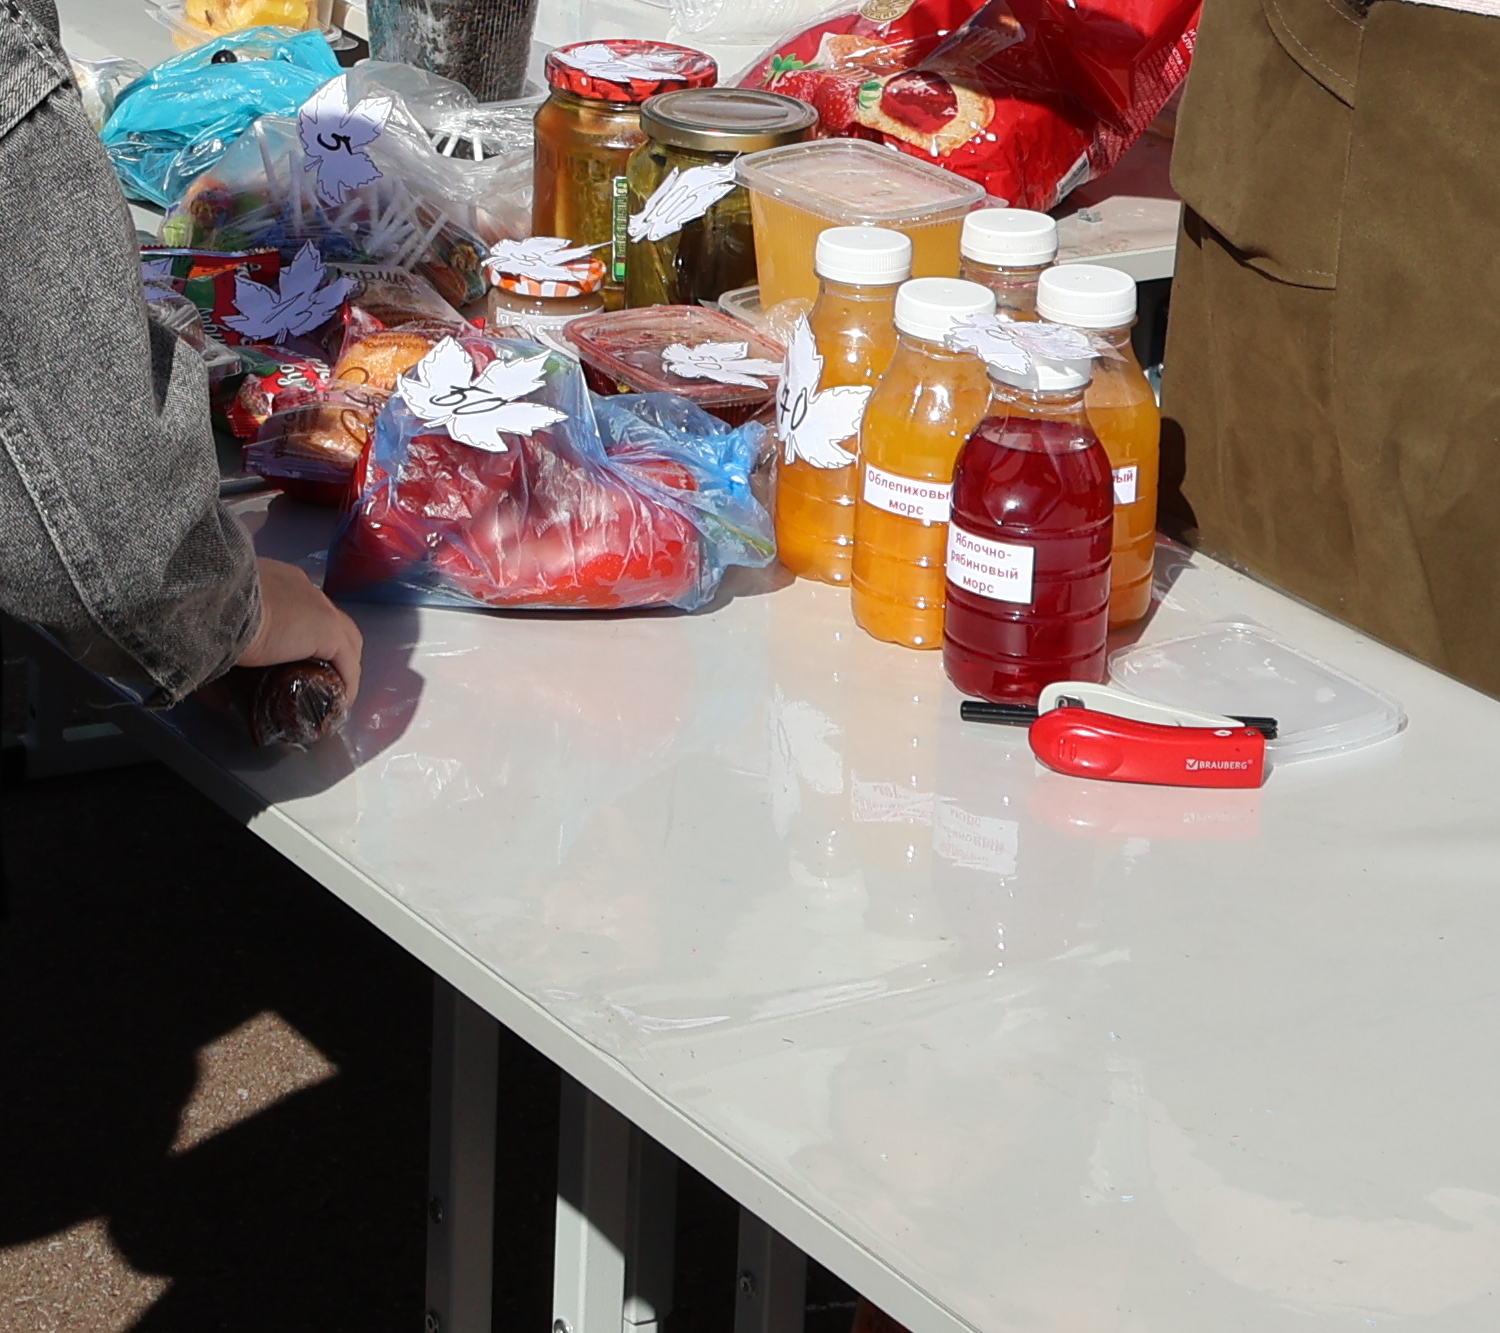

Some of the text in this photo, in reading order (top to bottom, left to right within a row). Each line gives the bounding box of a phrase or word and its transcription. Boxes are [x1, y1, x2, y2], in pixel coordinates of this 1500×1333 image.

[430, 386, 508, 416] 50
[867, 469, 952, 501] Облепиховы
[1113, 469, 1133, 484] ый
[888, 498, 924, 516] морс
[955, 532, 1012, 560] Яблочно-
[951, 550, 1019, 581] рябиновый
[962, 574, 995, 595] морс
[1199, 760, 1248, 770] BRAUBERG
